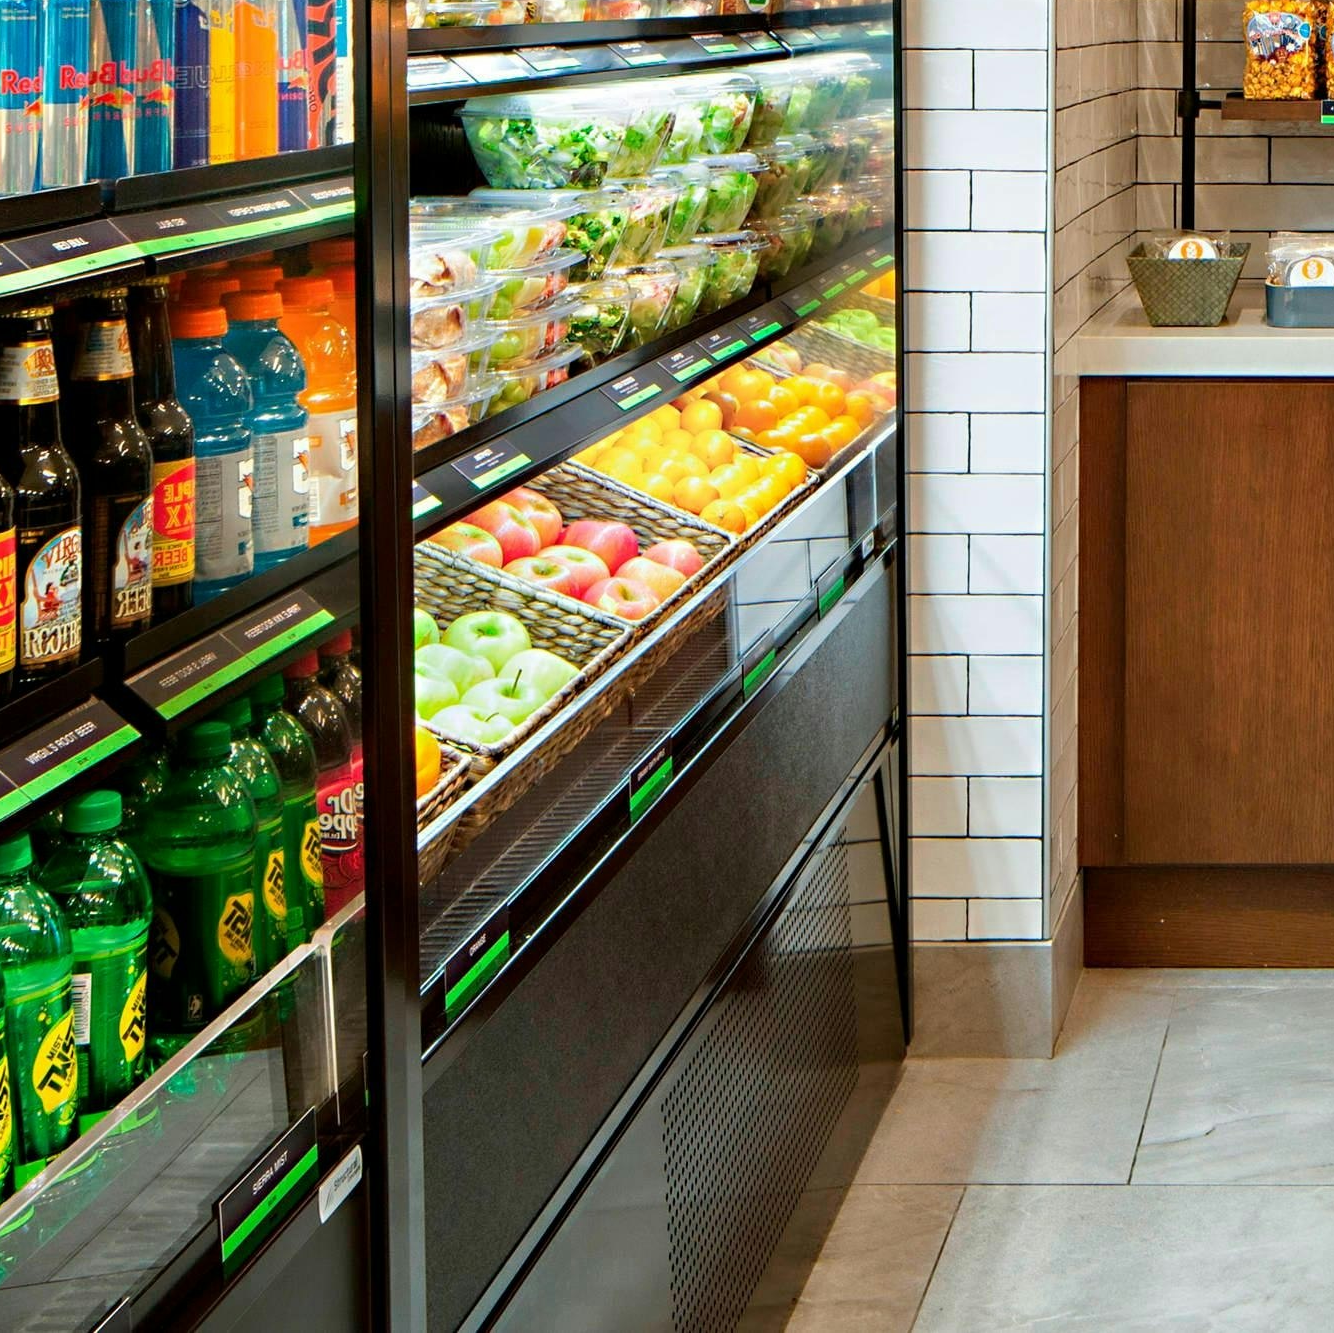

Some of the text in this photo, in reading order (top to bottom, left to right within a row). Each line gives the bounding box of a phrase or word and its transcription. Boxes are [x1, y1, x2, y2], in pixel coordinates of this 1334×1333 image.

[52, 240, 70, 252] RED
[56, 732, 79, 754] ROOT
[76, 721, 97, 742] BEER
[131, 989, 144, 1012] MIST
[47, 1034, 63, 1061] MIST
[252, 1150, 289, 1195] SIERRA MIST
